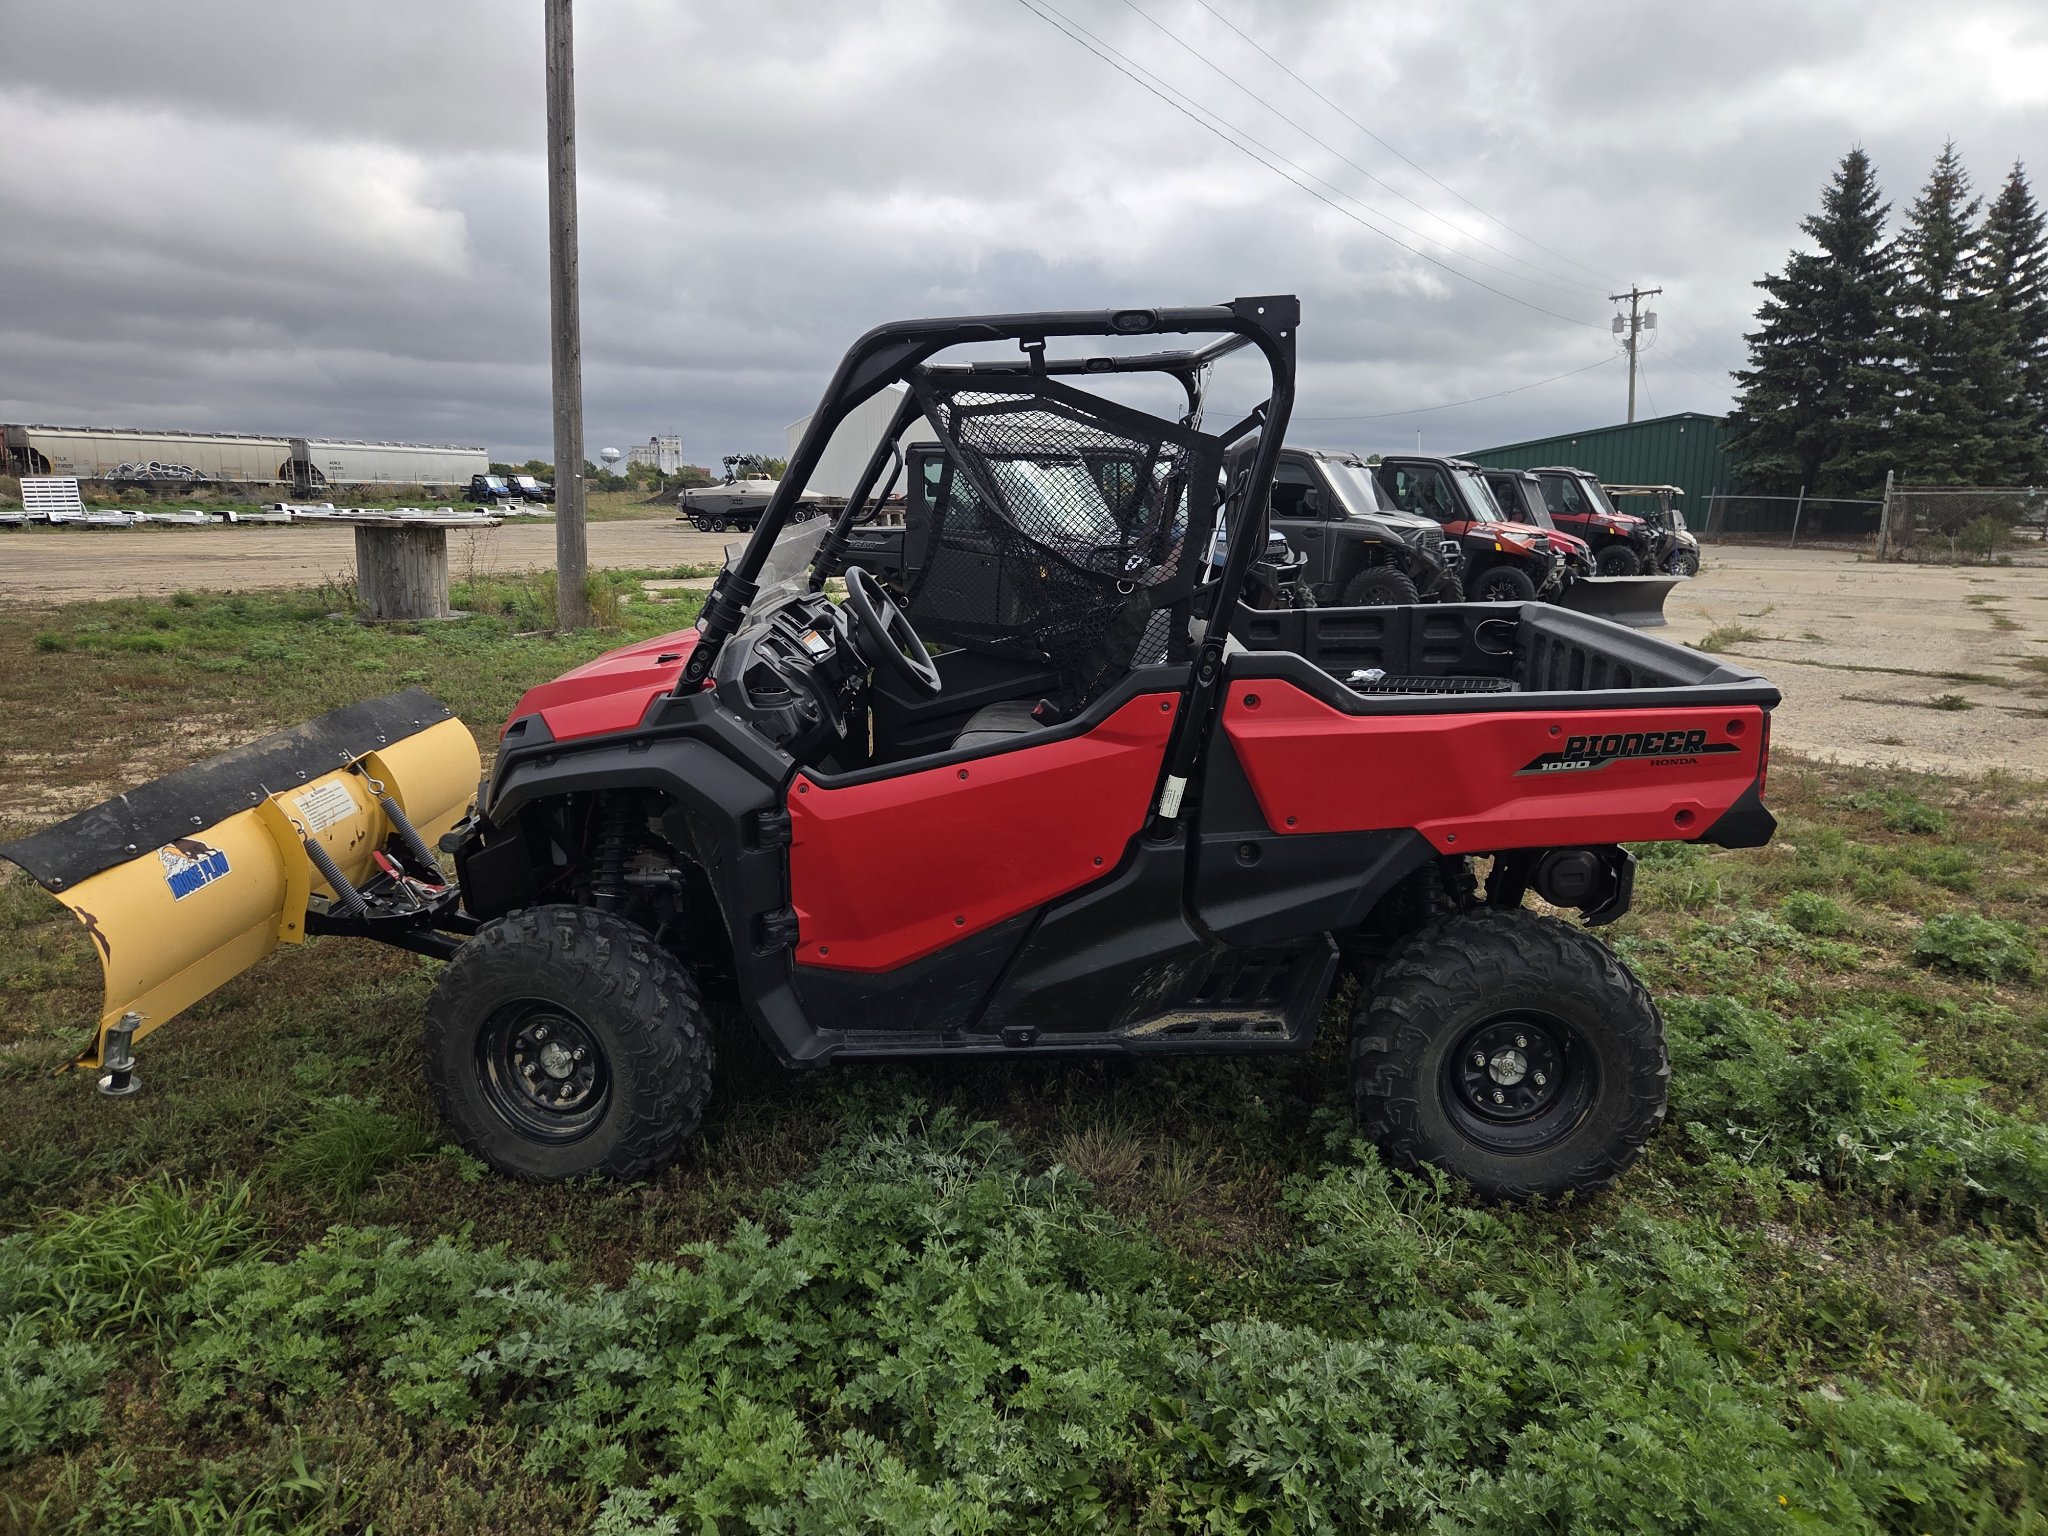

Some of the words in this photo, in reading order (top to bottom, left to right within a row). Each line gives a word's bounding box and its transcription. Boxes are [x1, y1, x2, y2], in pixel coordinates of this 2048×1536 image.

[1562, 729, 1708, 759] PIONEER
[1541, 760, 1590, 771] 1000
[1650, 757, 1697, 767] HONDA
[167, 863, 207, 899] MOOSE
[199, 850, 230, 882] PLOW
